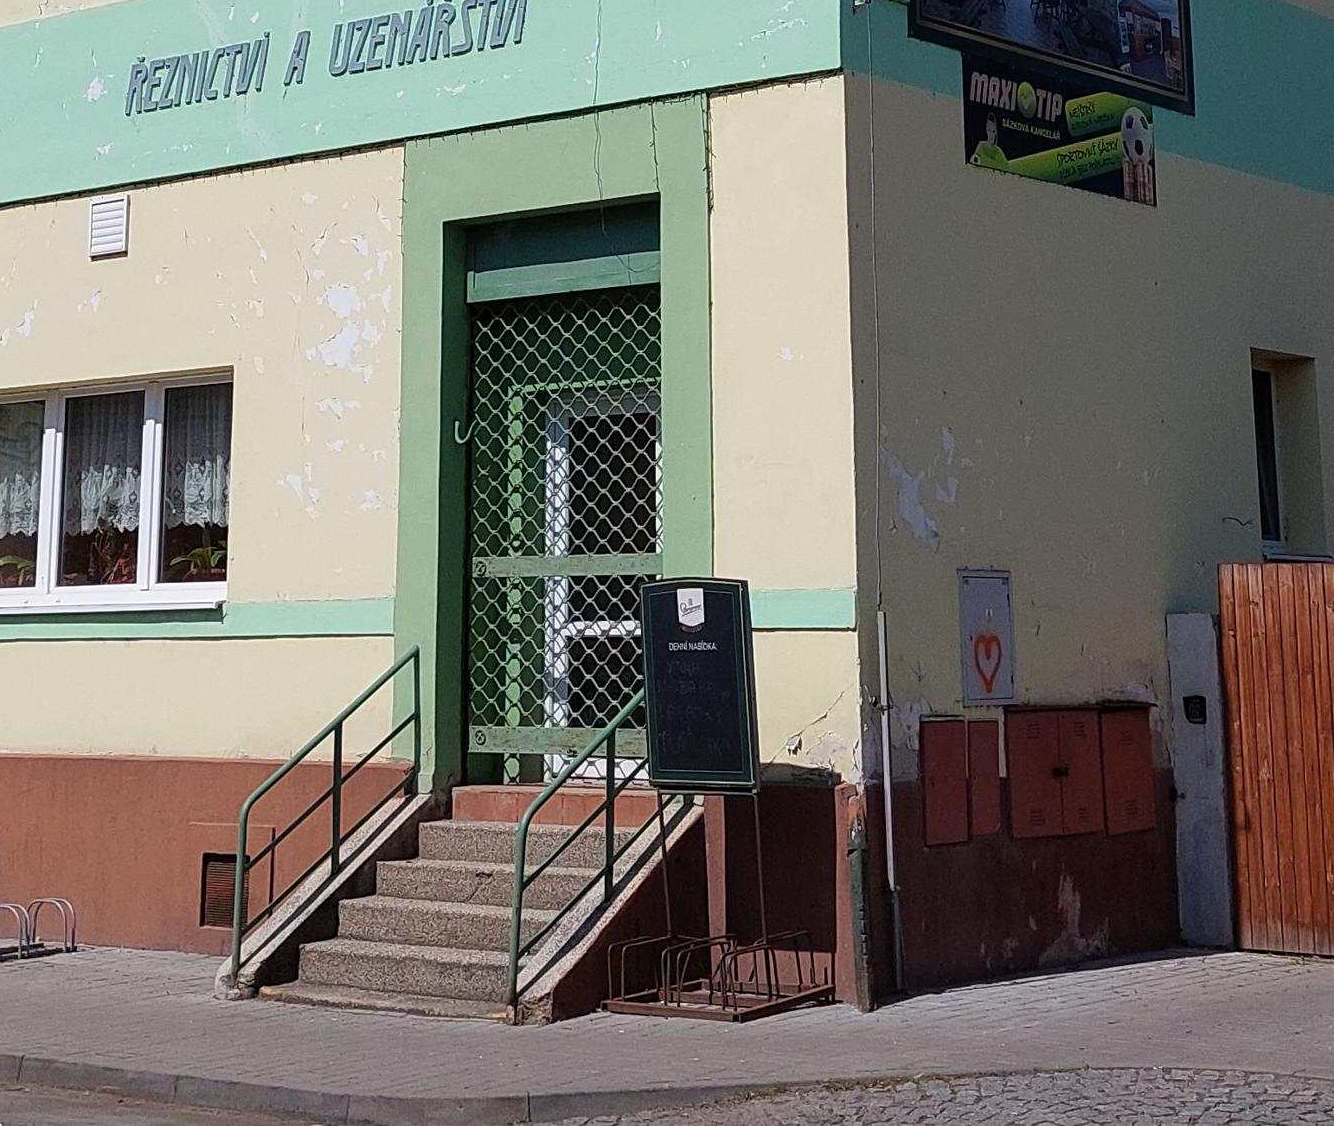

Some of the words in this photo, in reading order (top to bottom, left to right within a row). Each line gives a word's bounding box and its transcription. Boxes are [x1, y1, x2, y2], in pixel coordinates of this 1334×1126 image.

[124, 31, 271, 117] ŘEZNICTVÍ
[282, 30, 312, 87] A
[969, 70, 1017, 112] MAXI
[1036, 87, 1063, 123] TIP
